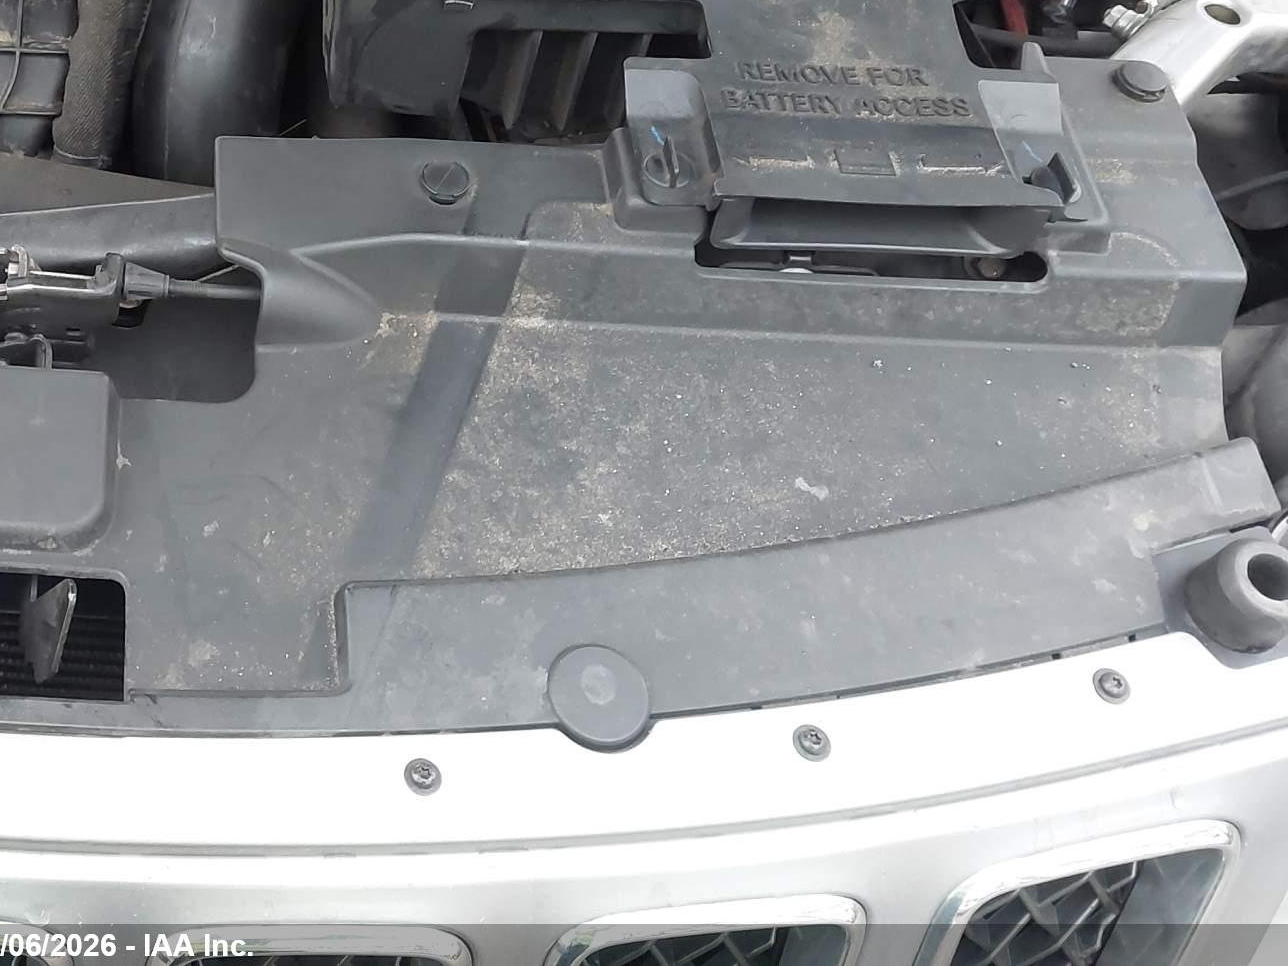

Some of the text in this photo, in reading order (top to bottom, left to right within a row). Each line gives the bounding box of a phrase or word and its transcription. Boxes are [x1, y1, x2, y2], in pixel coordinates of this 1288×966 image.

[736, 61, 929, 86] REMOVE FOR
[720, 88, 973, 117] BATTERY ACCESS
